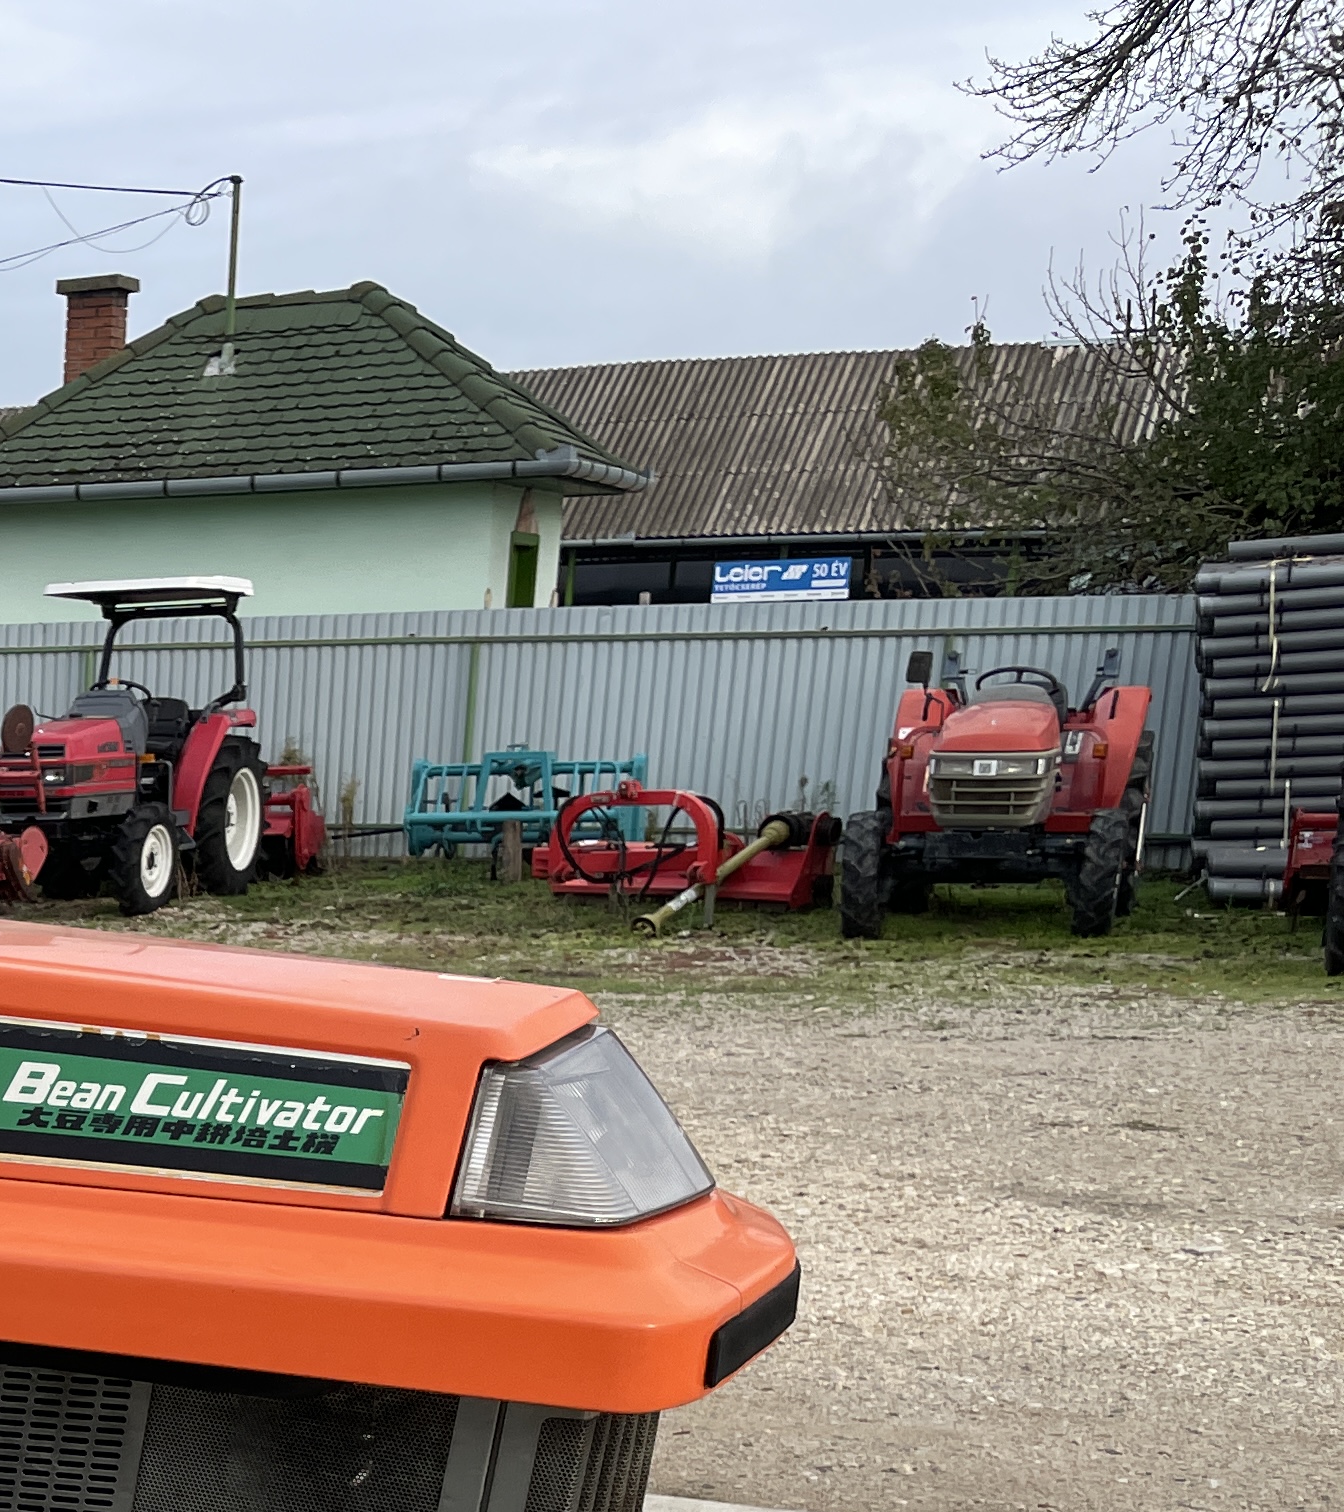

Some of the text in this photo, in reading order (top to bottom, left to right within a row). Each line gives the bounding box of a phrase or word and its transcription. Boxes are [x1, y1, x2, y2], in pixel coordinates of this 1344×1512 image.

[715, 560, 848, 582] Leier 50 ÉV
[2, 1061, 127, 1112] Bean
[130, 1073, 385, 1134] Cultivator
